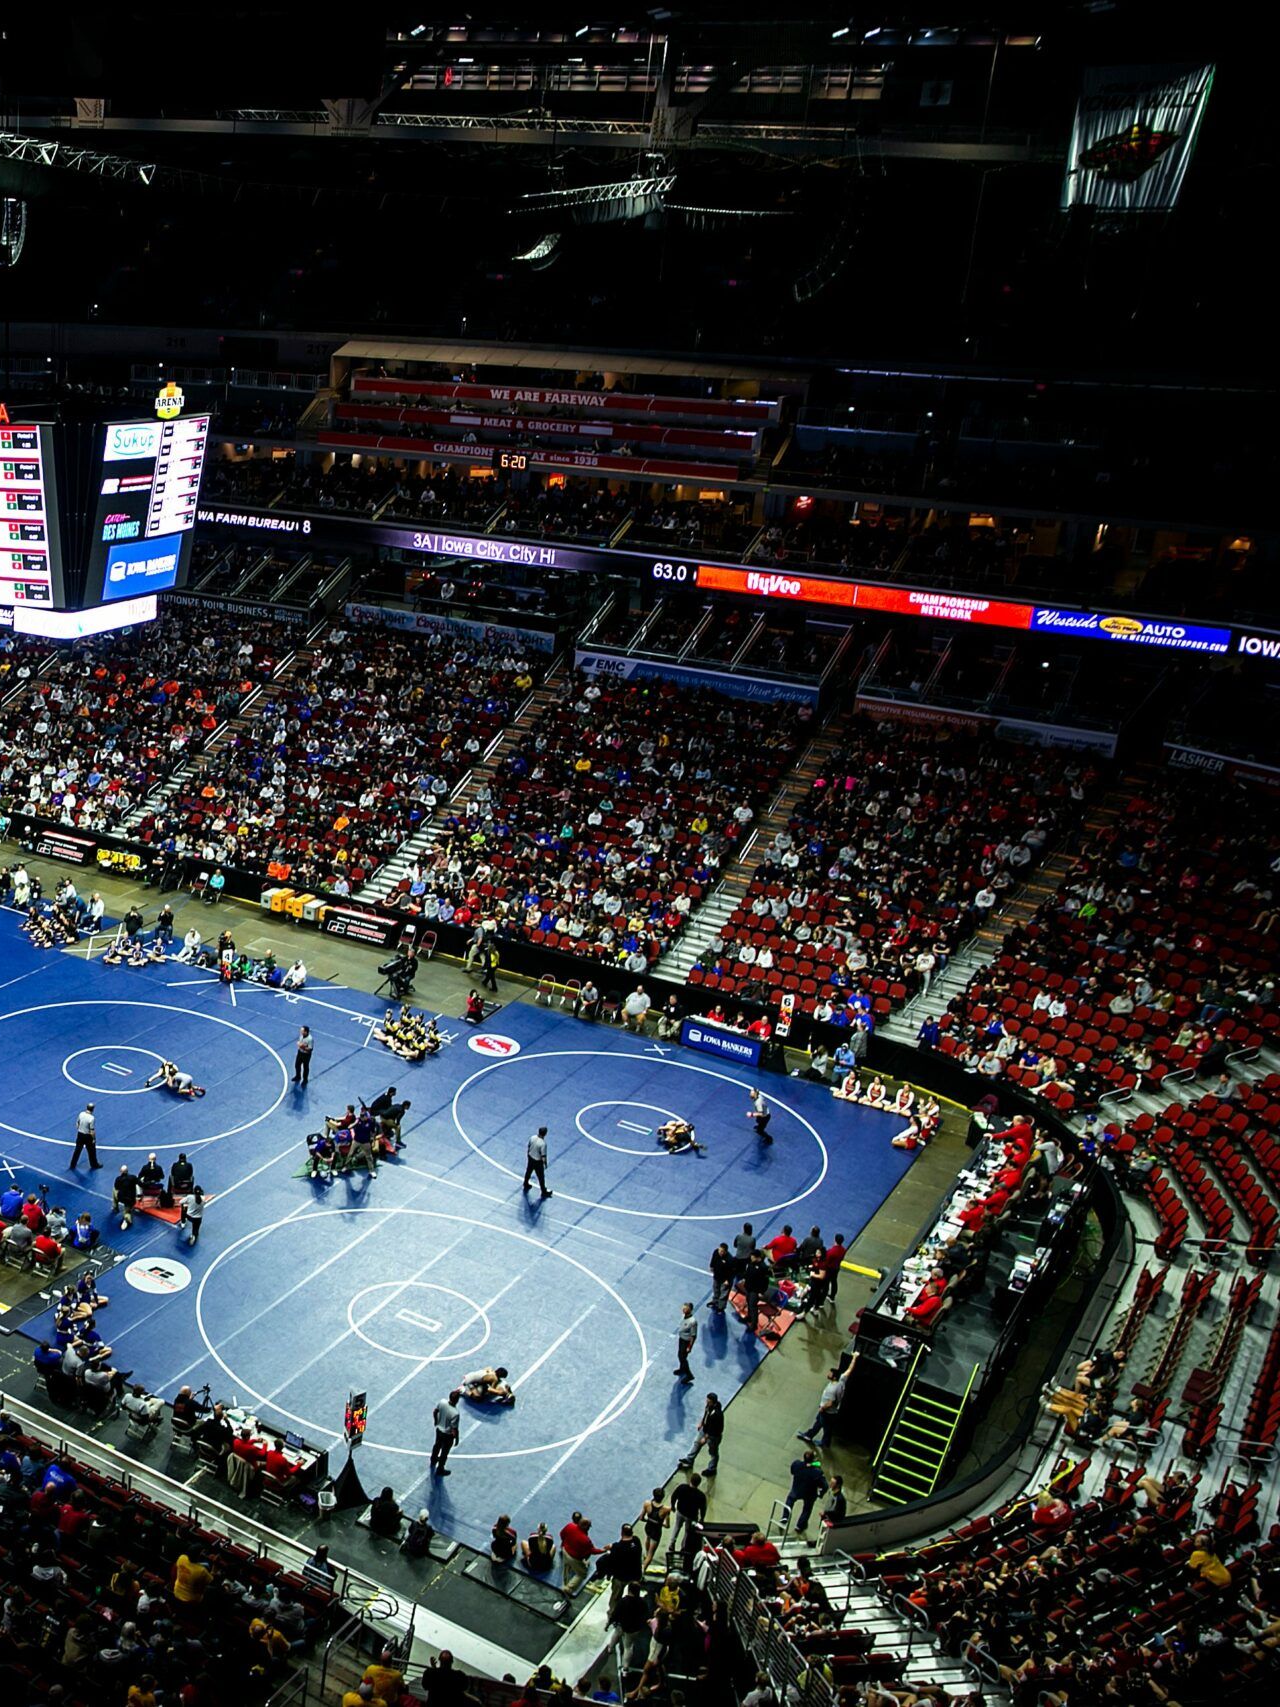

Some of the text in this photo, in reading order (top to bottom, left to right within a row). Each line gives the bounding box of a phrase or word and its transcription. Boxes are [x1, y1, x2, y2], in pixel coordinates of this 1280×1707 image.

[156, 397, 183, 407] ARENA
[490, 389, 608, 407] WE ARE FAREWAY
[483, 417, 577, 433] MEAT & GROCERY
[433, 443, 495, 457] CHAMPIONS
[500, 453, 527, 469] 6:20
[215, 513, 247, 526] FARM
[248, 516, 295, 531] BUREAU
[302, 520, 311, 533] 8
[414, 533, 431, 549] 3A
[441, 537, 473, 554] Iowa
[509, 547, 537, 564] City
[540, 550, 555, 564] Hi
[653, 563, 687, 581] 63.0
[747, 572, 801, 595] HyVee
[909, 592, 989, 611] CHAMPIONSHIP
[920, 605, 972, 620] NETWORK
[1036, 610, 1098, 629] Westside
[1142, 623, 1186, 638] AUTO
[596, 659, 625, 672] EMC
[858, 703, 901, 716] INNOVATIVE
[902, 709, 945, 722] INSURANCE
[703, 1035, 753, 1055] IOWA BANKERS
